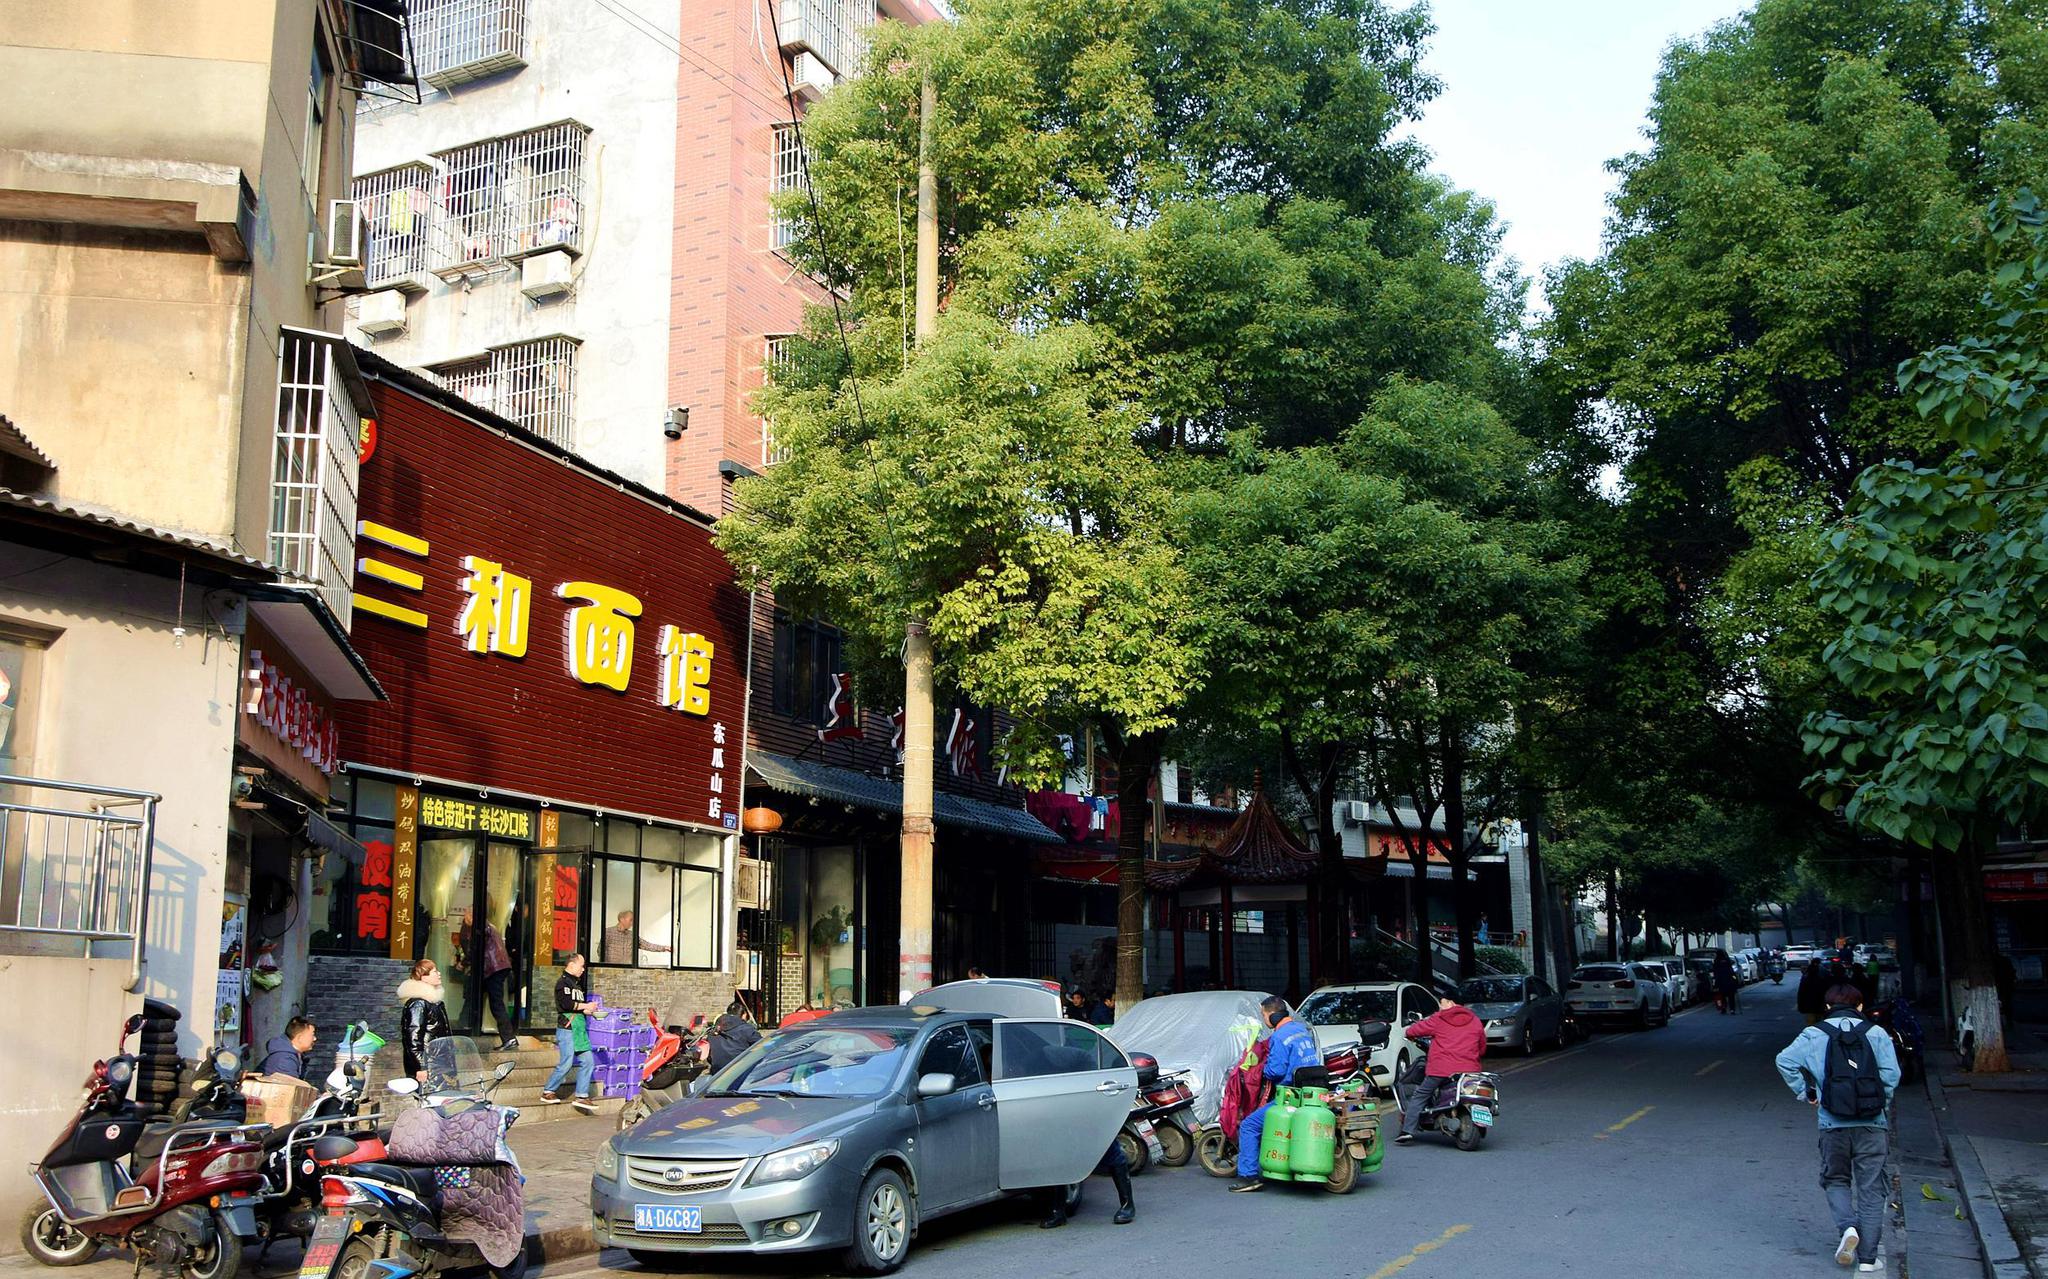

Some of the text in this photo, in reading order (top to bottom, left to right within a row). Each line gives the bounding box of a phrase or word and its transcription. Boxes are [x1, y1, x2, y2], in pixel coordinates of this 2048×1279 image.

[353, 519, 714, 716] 三和面馆
[422, 797, 529, 837] 特色带迅干 老长沙口味
